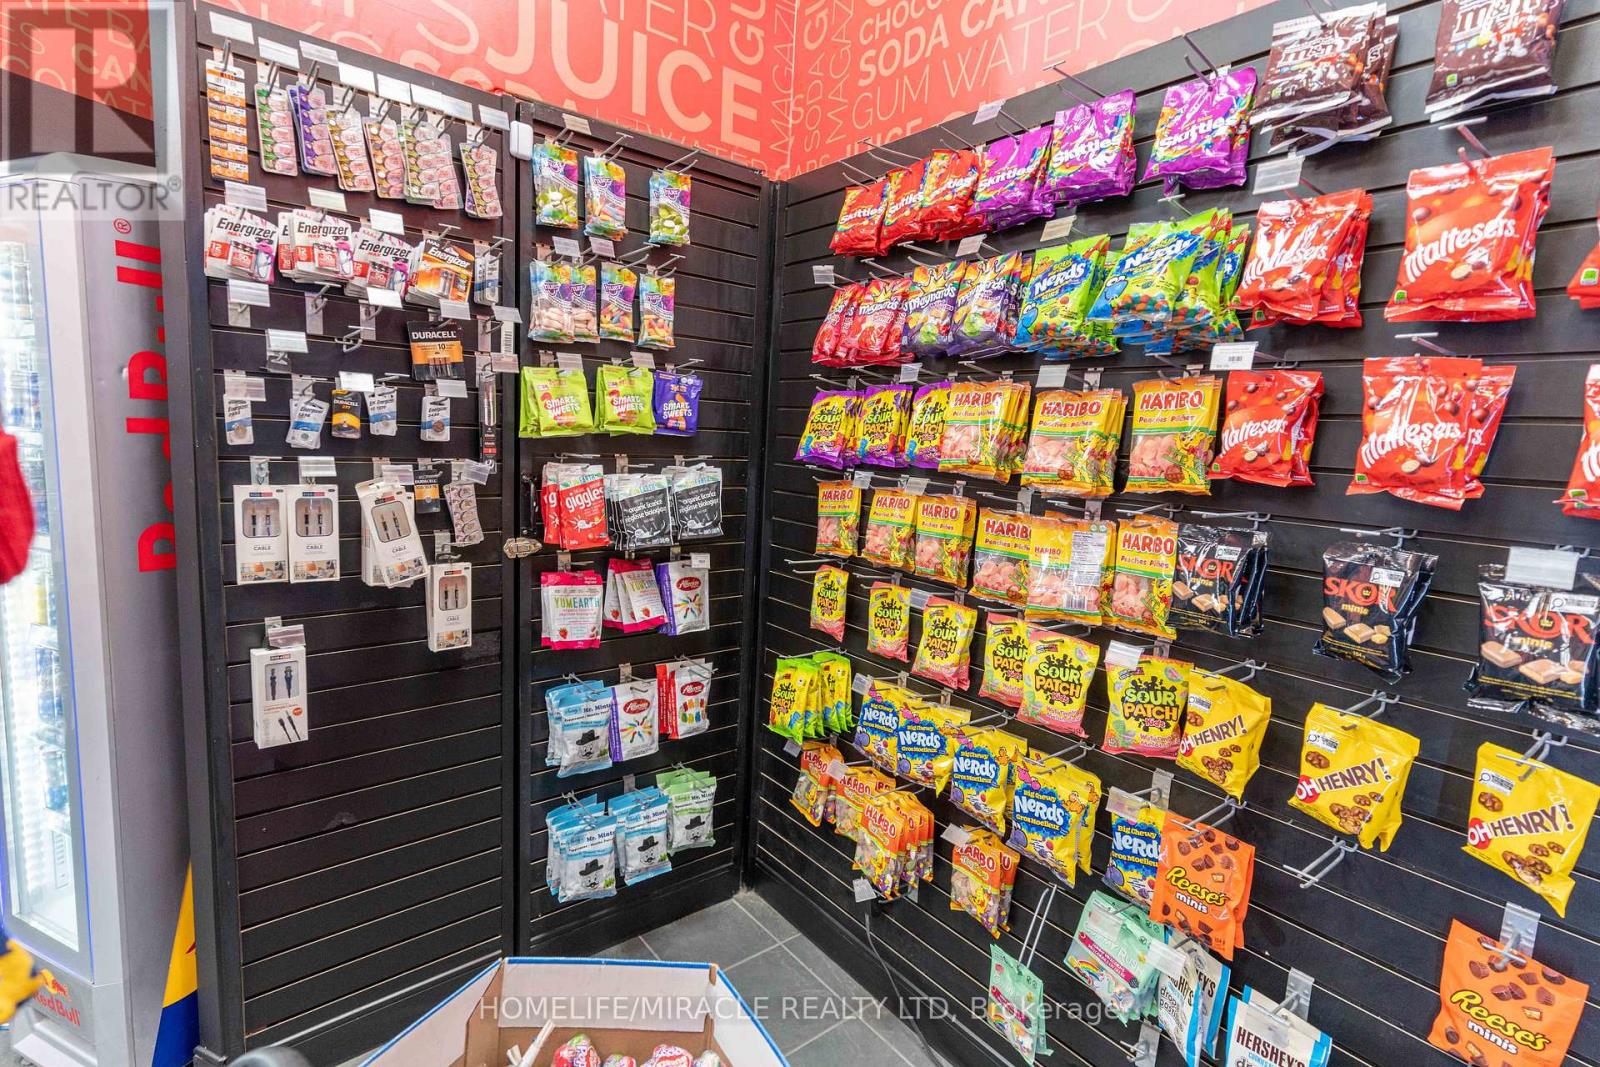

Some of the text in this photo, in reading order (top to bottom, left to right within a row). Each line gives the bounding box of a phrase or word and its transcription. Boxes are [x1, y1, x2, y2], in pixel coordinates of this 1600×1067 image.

[858, 14, 950, 87] SODA
[852, 0, 1108, 130] GUM WATER
[485, 0, 763, 154] JUICE
[804, 52, 825, 153] SODA
[1158, 115, 1237, 150] Skittles
[1055, 134, 1124, 168] Skittles
[979, 160, 1044, 193] Skittles
[839, 207, 885, 225] Skittles
[217, 217, 277, 241] Energizer
[298, 221, 350, 238] Energizer
[359, 239, 412, 262] Energizer
[428, 246, 471, 269] Energizer
[1403, 217, 1517, 284] maltesers
[411, 330, 457, 340] DURACELL
[546, 396, 577, 410] SMART
[613, 395, 642, 407] SMART
[614, 402, 645, 416] SWEETS
[663, 402, 690, 412] SMART
[953, 390, 1002, 407] HARIBO
[1039, 401, 1102, 418] HARIBO
[1139, 389, 1204, 411] HARIBO
[549, 403, 581, 418] SWEETS
[663, 408, 692, 421] SWEETS
[812, 413, 842, 424] SOUR
[866, 412, 892, 425] SOUR
[914, 412, 944, 425] SOUR
[809, 421, 840, 435] PATCH
[863, 422, 894, 436] PATCH
[911, 423, 944, 438] PATCH
[1219, 419, 1288, 455] maltesers
[822, 488, 854, 502] HARIBO
[876, 495, 911, 510] HARIBO
[921, 502, 958, 521] HARIBO
[1034, 545, 1062, 556] HARIBO
[1121, 532, 1176, 556] HARIBO
[816, 596, 838, 612] PATCH
[820, 587, 838, 600] SOUR
[1324, 576, 1398, 613] SKOR
[877, 607, 902, 621] SOUR
[1341, 602, 1371, 615] minis
[875, 617, 901, 632] PATCH
[1484, 605, 1597, 645] SKOR
[924, 637, 958, 656] PATCH
[928, 627, 958, 645] SOUR
[1037, 661, 1080, 688] SOUR
[1035, 679, 1080, 704] PATCH
[1124, 688, 1175, 706] SOUR
[864, 707, 898, 729] Nerds
[1122, 702, 1178, 724] PATCH
[900, 731, 941, 751] Nerds
[1179, 714, 1249, 756] OH HENRY!
[804, 751, 829, 774] HARIBO
[953, 757, 996, 779] Nerds
[1296, 757, 1392, 800] OH HENRY!
[863, 805, 897, 839] HARIBO
[1015, 796, 1065, 826] Nerds
[1467, 802, 1575, 847] OH HENRY!
[1165, 865, 1229, 907] Reese's
[1176, 889, 1208, 914] minis
[1450, 989, 1551, 1053] Reese's
[1467, 1018, 1518, 1055] minis
